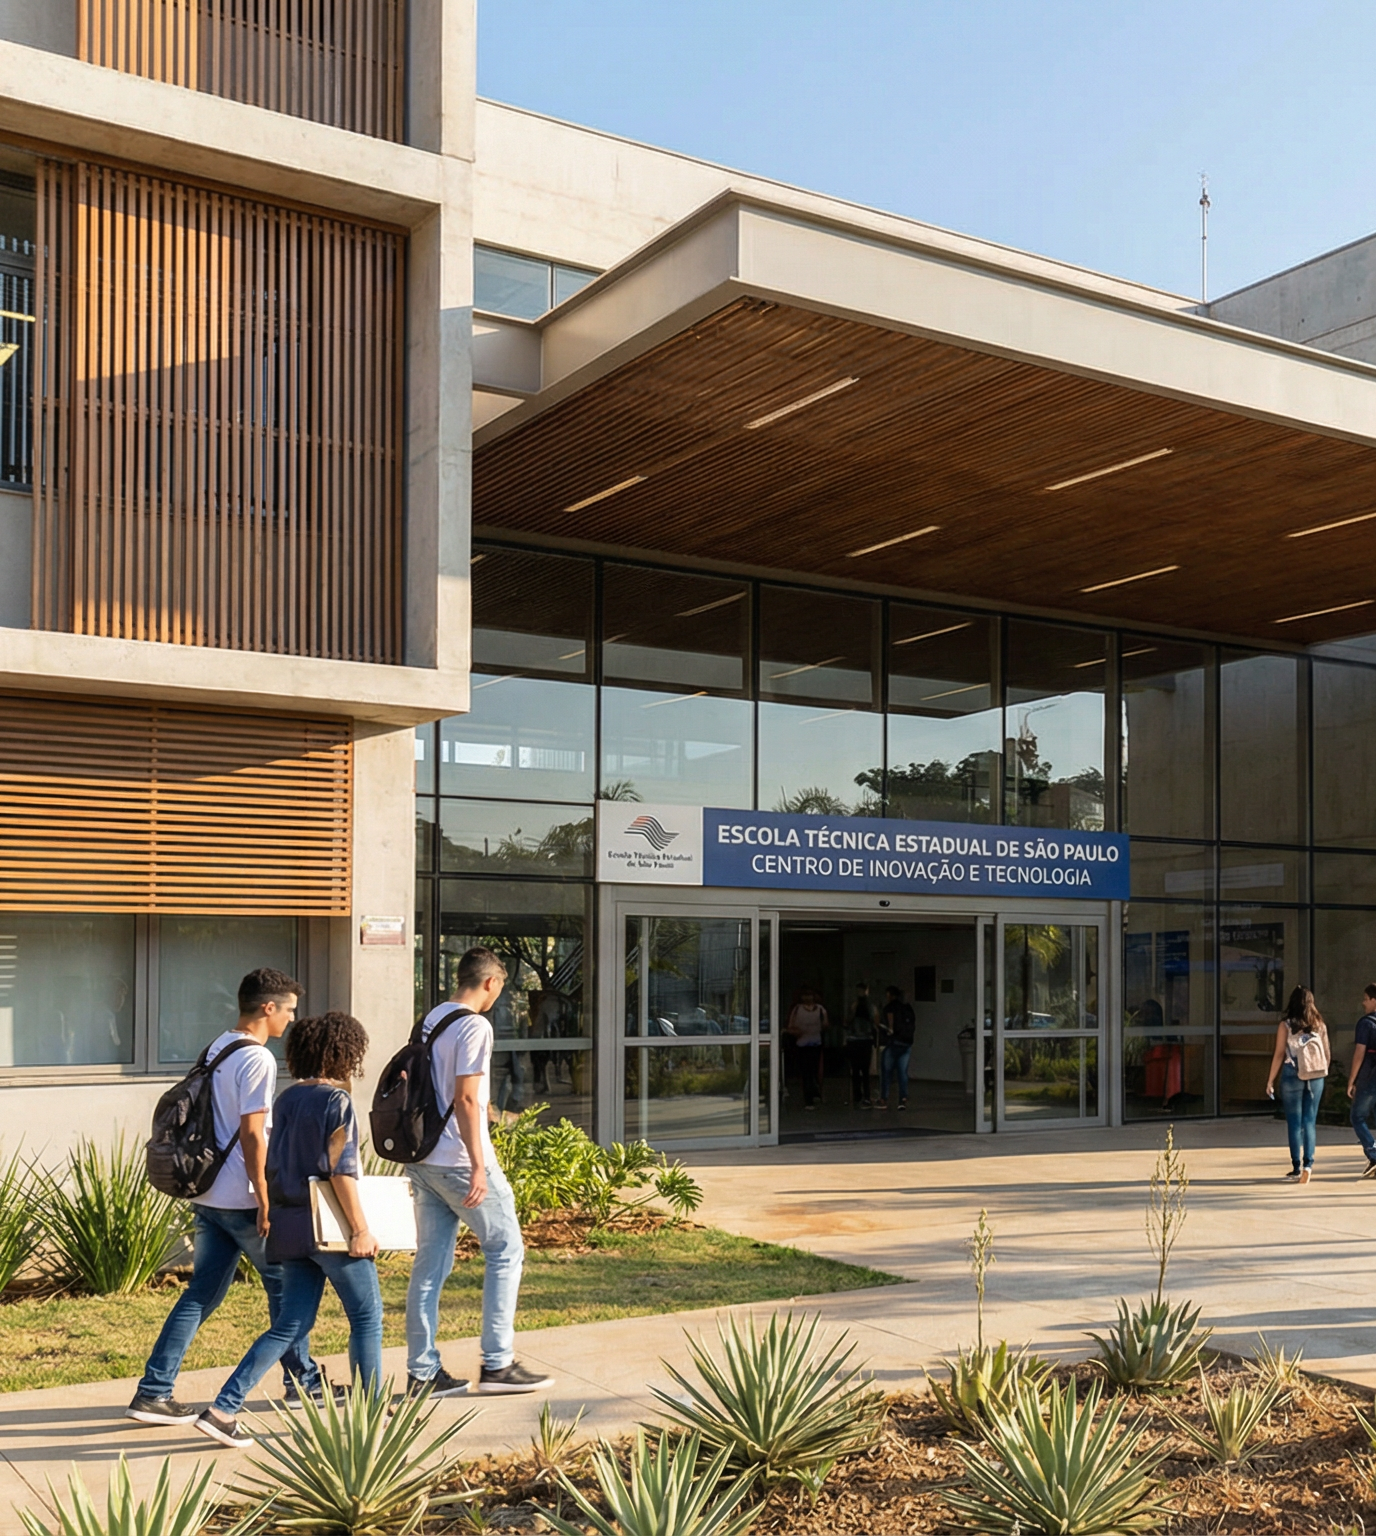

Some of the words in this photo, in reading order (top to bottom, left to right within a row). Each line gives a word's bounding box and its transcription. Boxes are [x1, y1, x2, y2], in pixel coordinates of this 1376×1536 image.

[718, 824, 801, 848] ESCOLA
[804, 825, 891, 851] TÉCNICA
[895, 834, 992, 856] ESTADUAL
[996, 840, 1020, 858] DE
[1024, 837, 1060, 860] SÃO
[1064, 843, 1119, 862] PAULO
[752, 854, 833, 876] CENTRO
[838, 858, 864, 877] DE
[869, 859, 965, 885] INOVAÇÃO
[969, 864, 980, 882] E
[984, 864, 1092, 886] TECNOLOGIA
